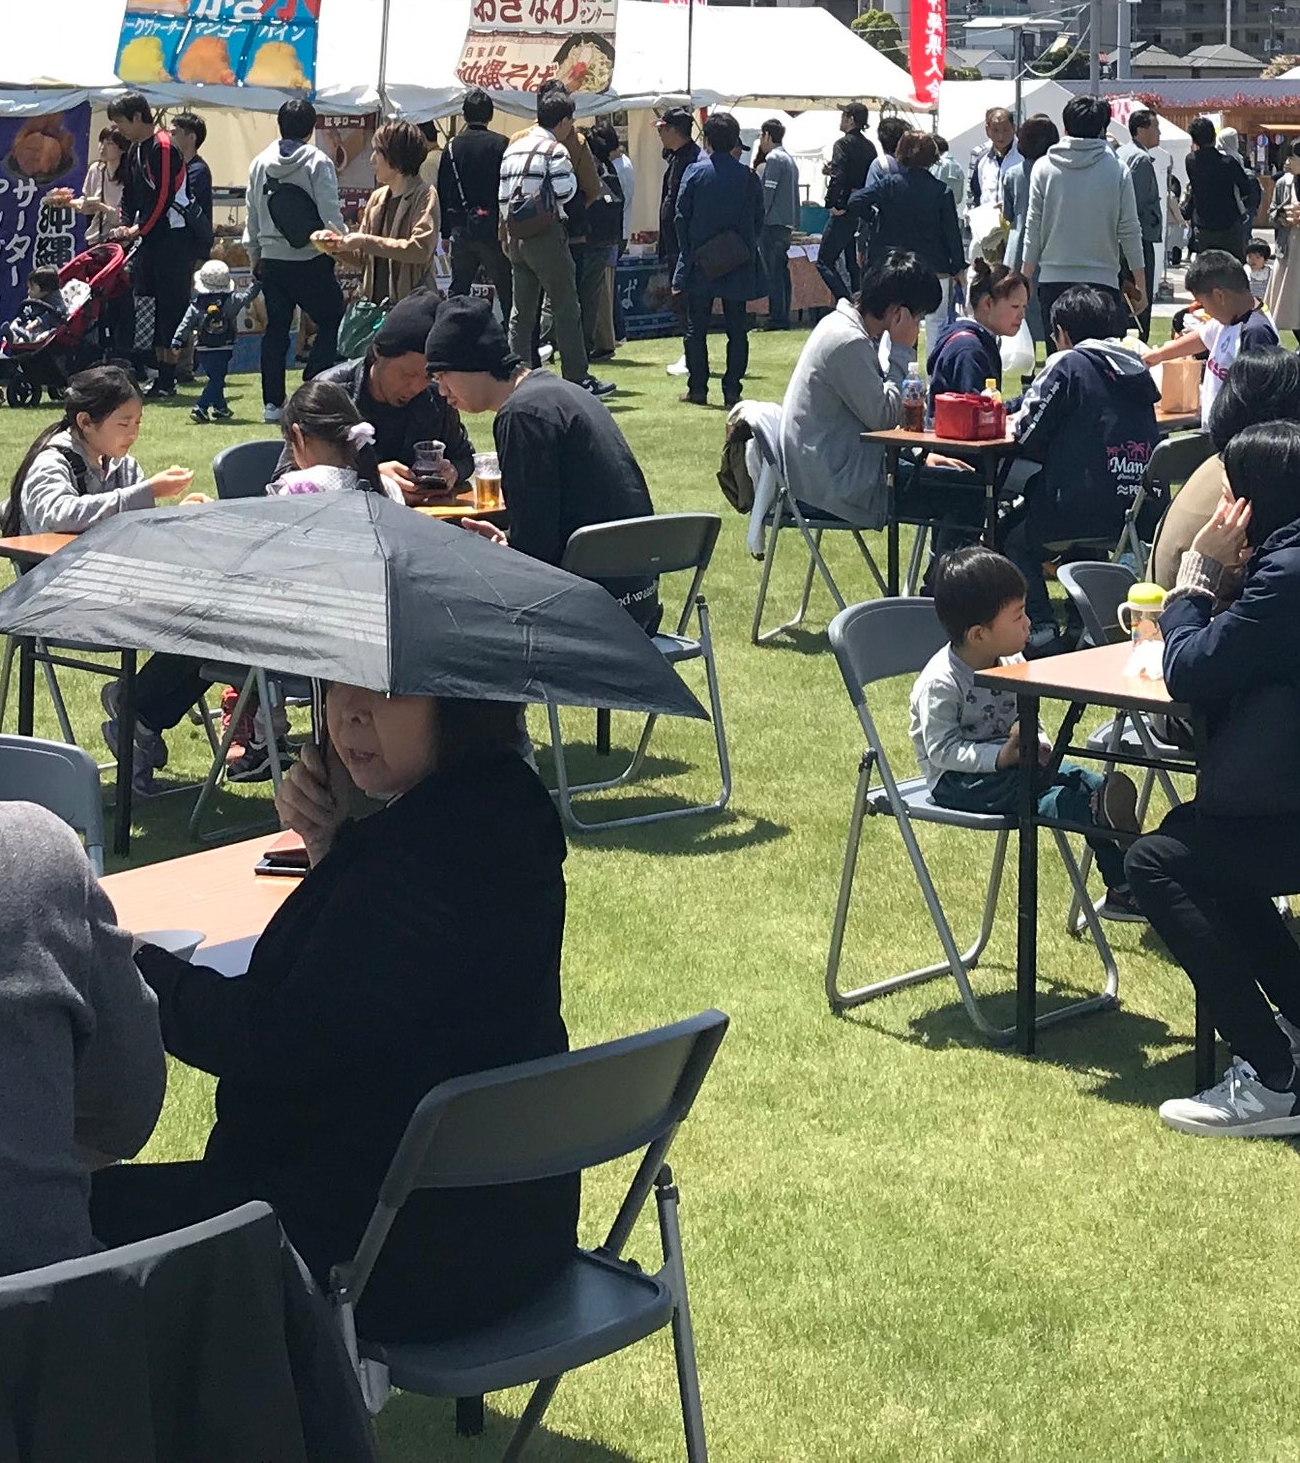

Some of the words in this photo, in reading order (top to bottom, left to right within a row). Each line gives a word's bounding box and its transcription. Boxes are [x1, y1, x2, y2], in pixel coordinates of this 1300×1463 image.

[194, 23, 246, 37] マンゴー
[258, 25, 306, 41] パイン
[5, 178, 38, 287] サーター
[35, 202, 74, 268] 沖縄
